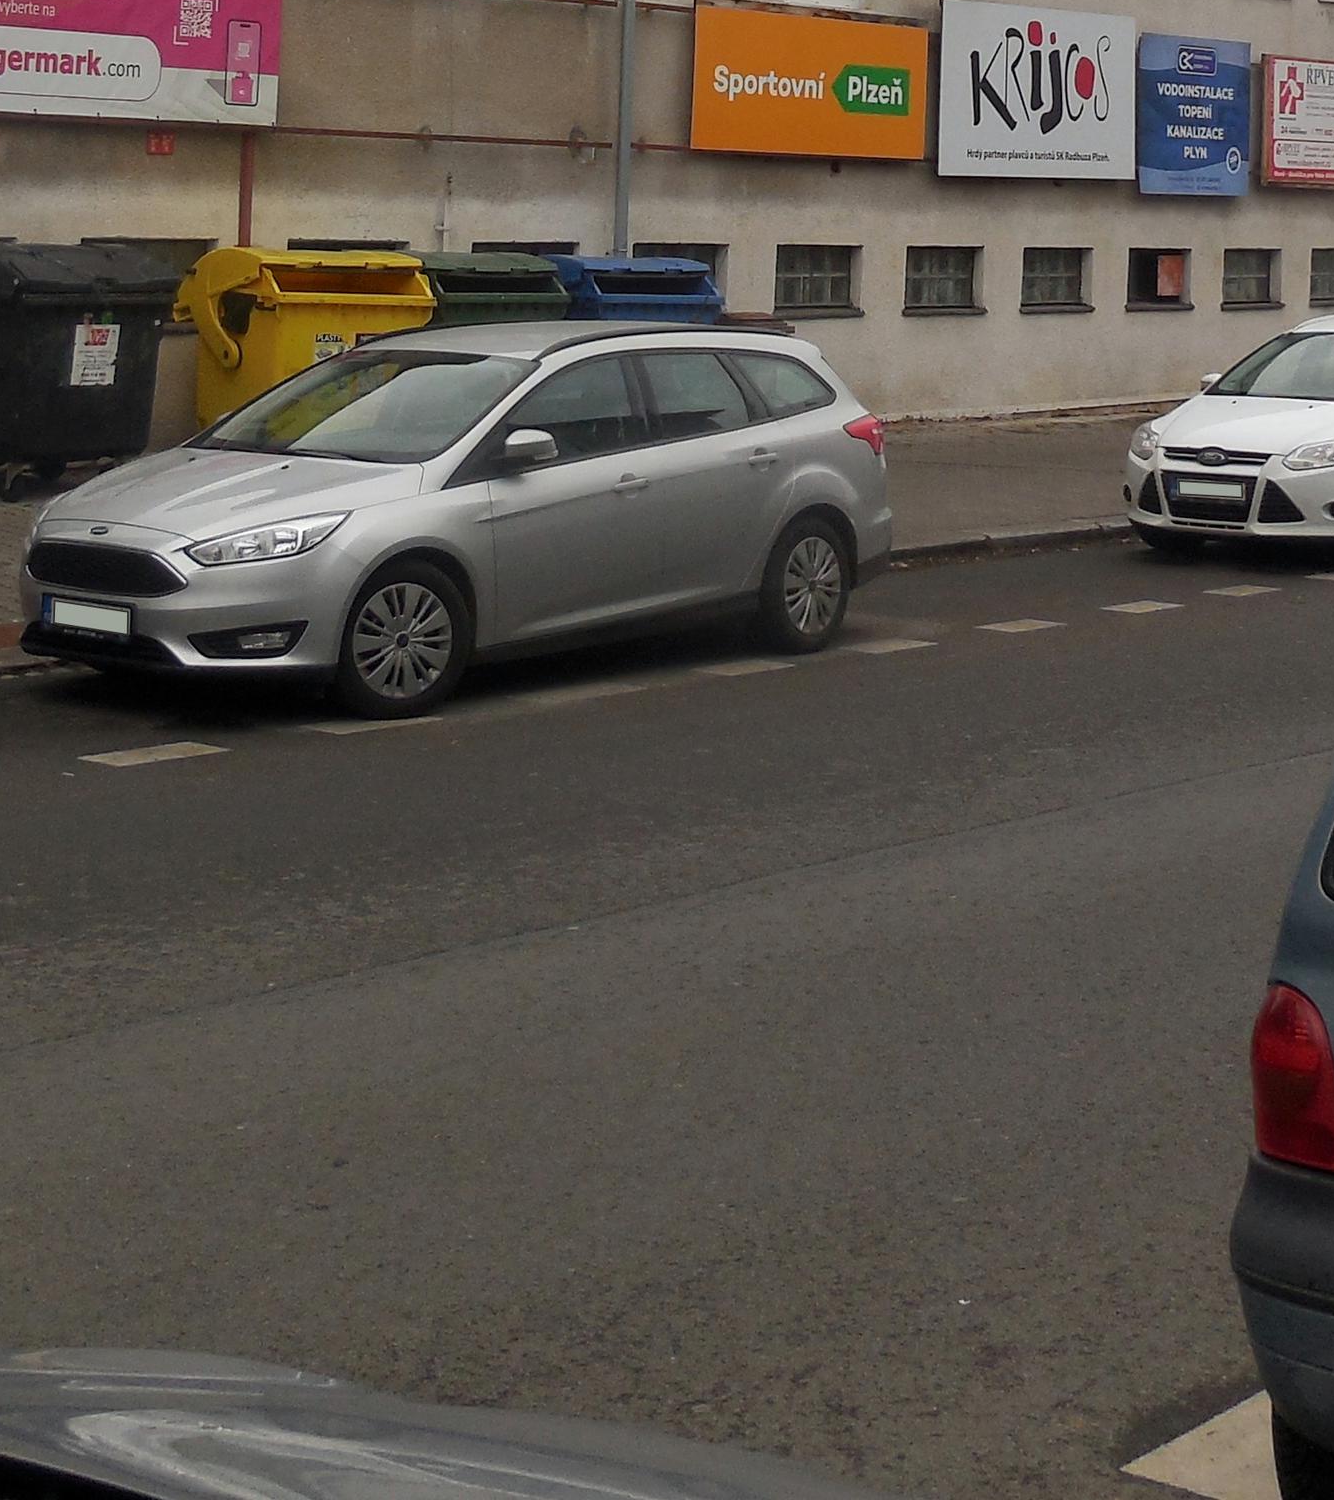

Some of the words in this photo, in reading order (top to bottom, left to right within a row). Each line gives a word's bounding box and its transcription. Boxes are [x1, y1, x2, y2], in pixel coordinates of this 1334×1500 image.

[0, 0, 40, 17] vyberte
[42, 5, 56, 17] na
[713, 64, 826, 101] Sportovní
[847, 76, 903, 106] Plzeň
[1157, 82, 1234, 100] VODOINSTALACE
[1178, 104, 1212, 120] TOPENÍ
[1167, 125, 1224, 140] KANALIZACE
[967, 149, 982, 161] Hrdý
[983, 150, 1007, 161] partner
[1056, 151, 1064, 160] SK
[1184, 146, 1208, 159] PLYN
